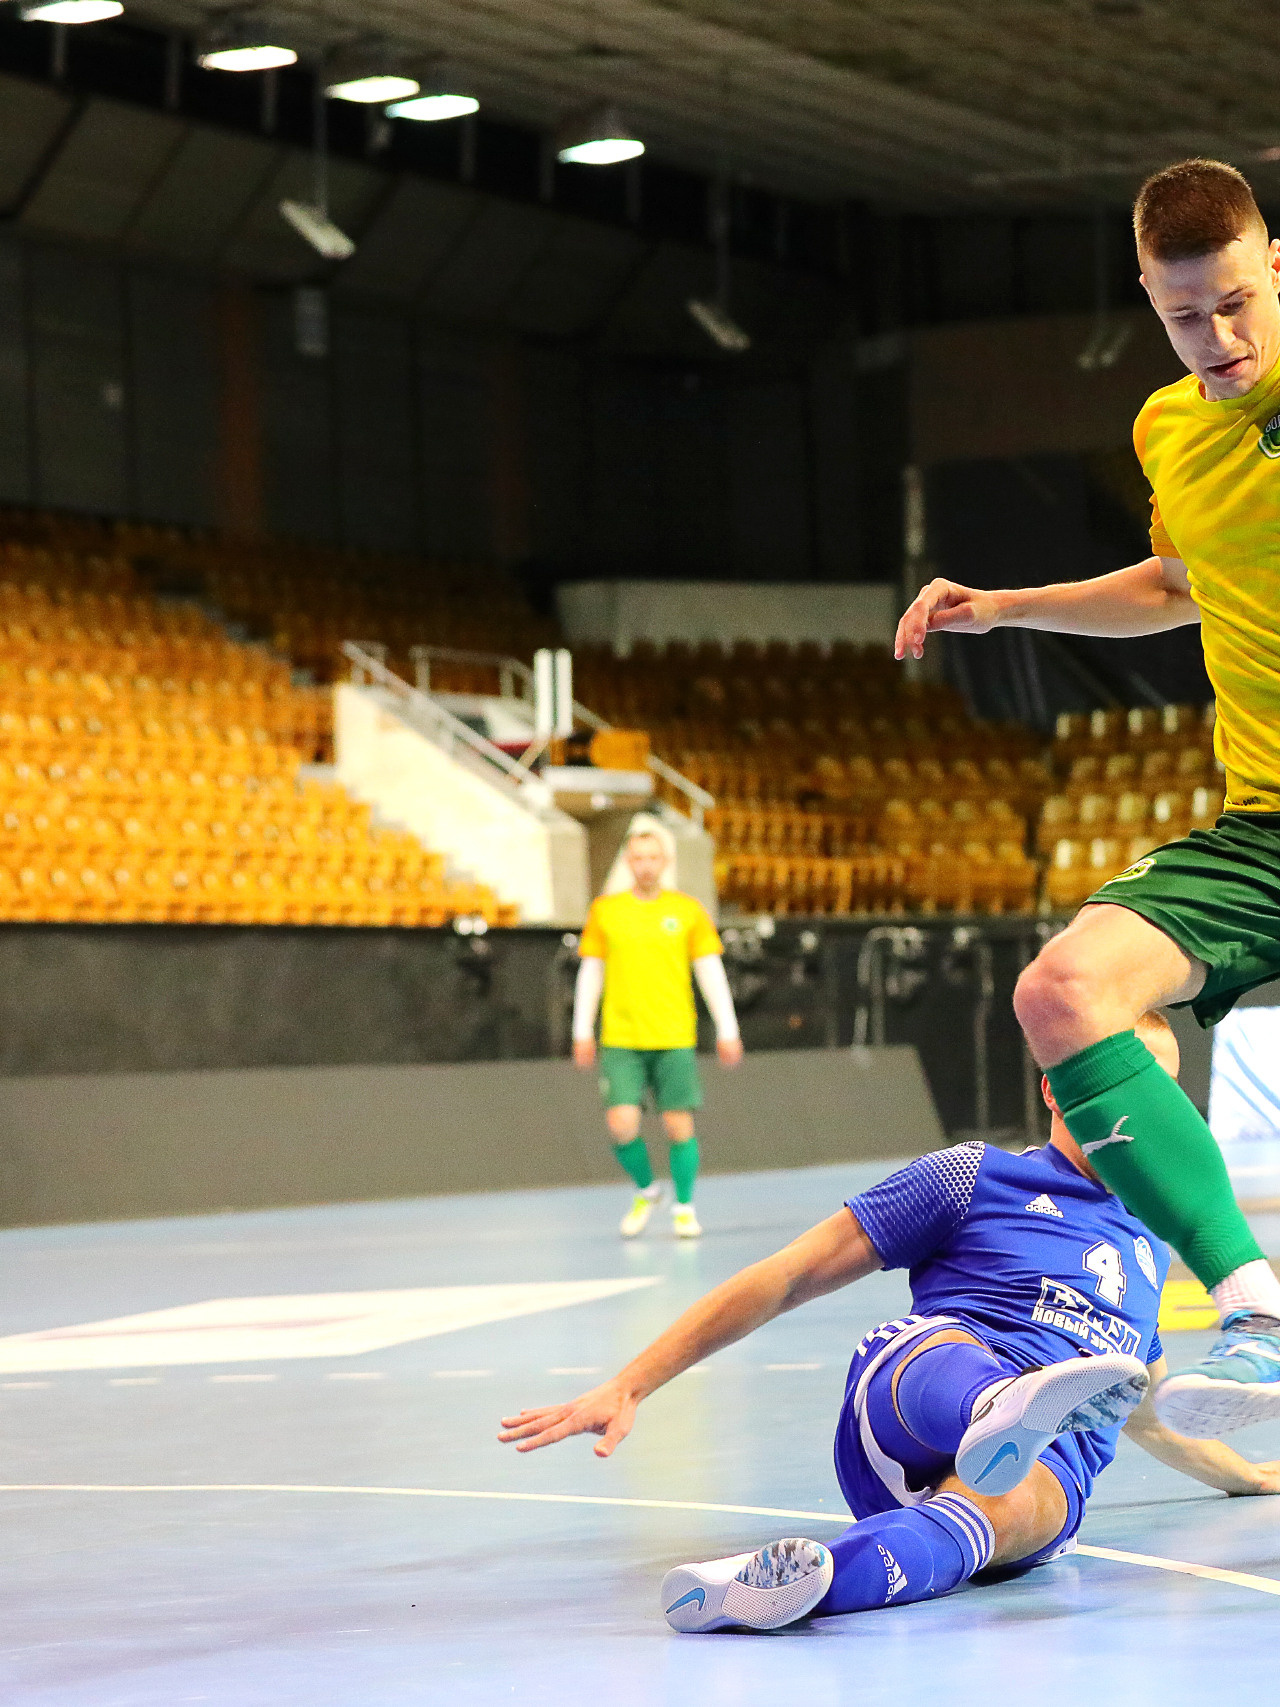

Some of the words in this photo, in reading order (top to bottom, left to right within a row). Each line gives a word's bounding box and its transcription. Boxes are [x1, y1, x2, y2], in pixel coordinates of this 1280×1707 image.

[1025, 1203, 1064, 1218] adidas
[1082, 1240, 1127, 1309] 4
[1031, 1305, 1090, 1341] НОВЫЙ
[877, 1544, 893, 1603] adidas
